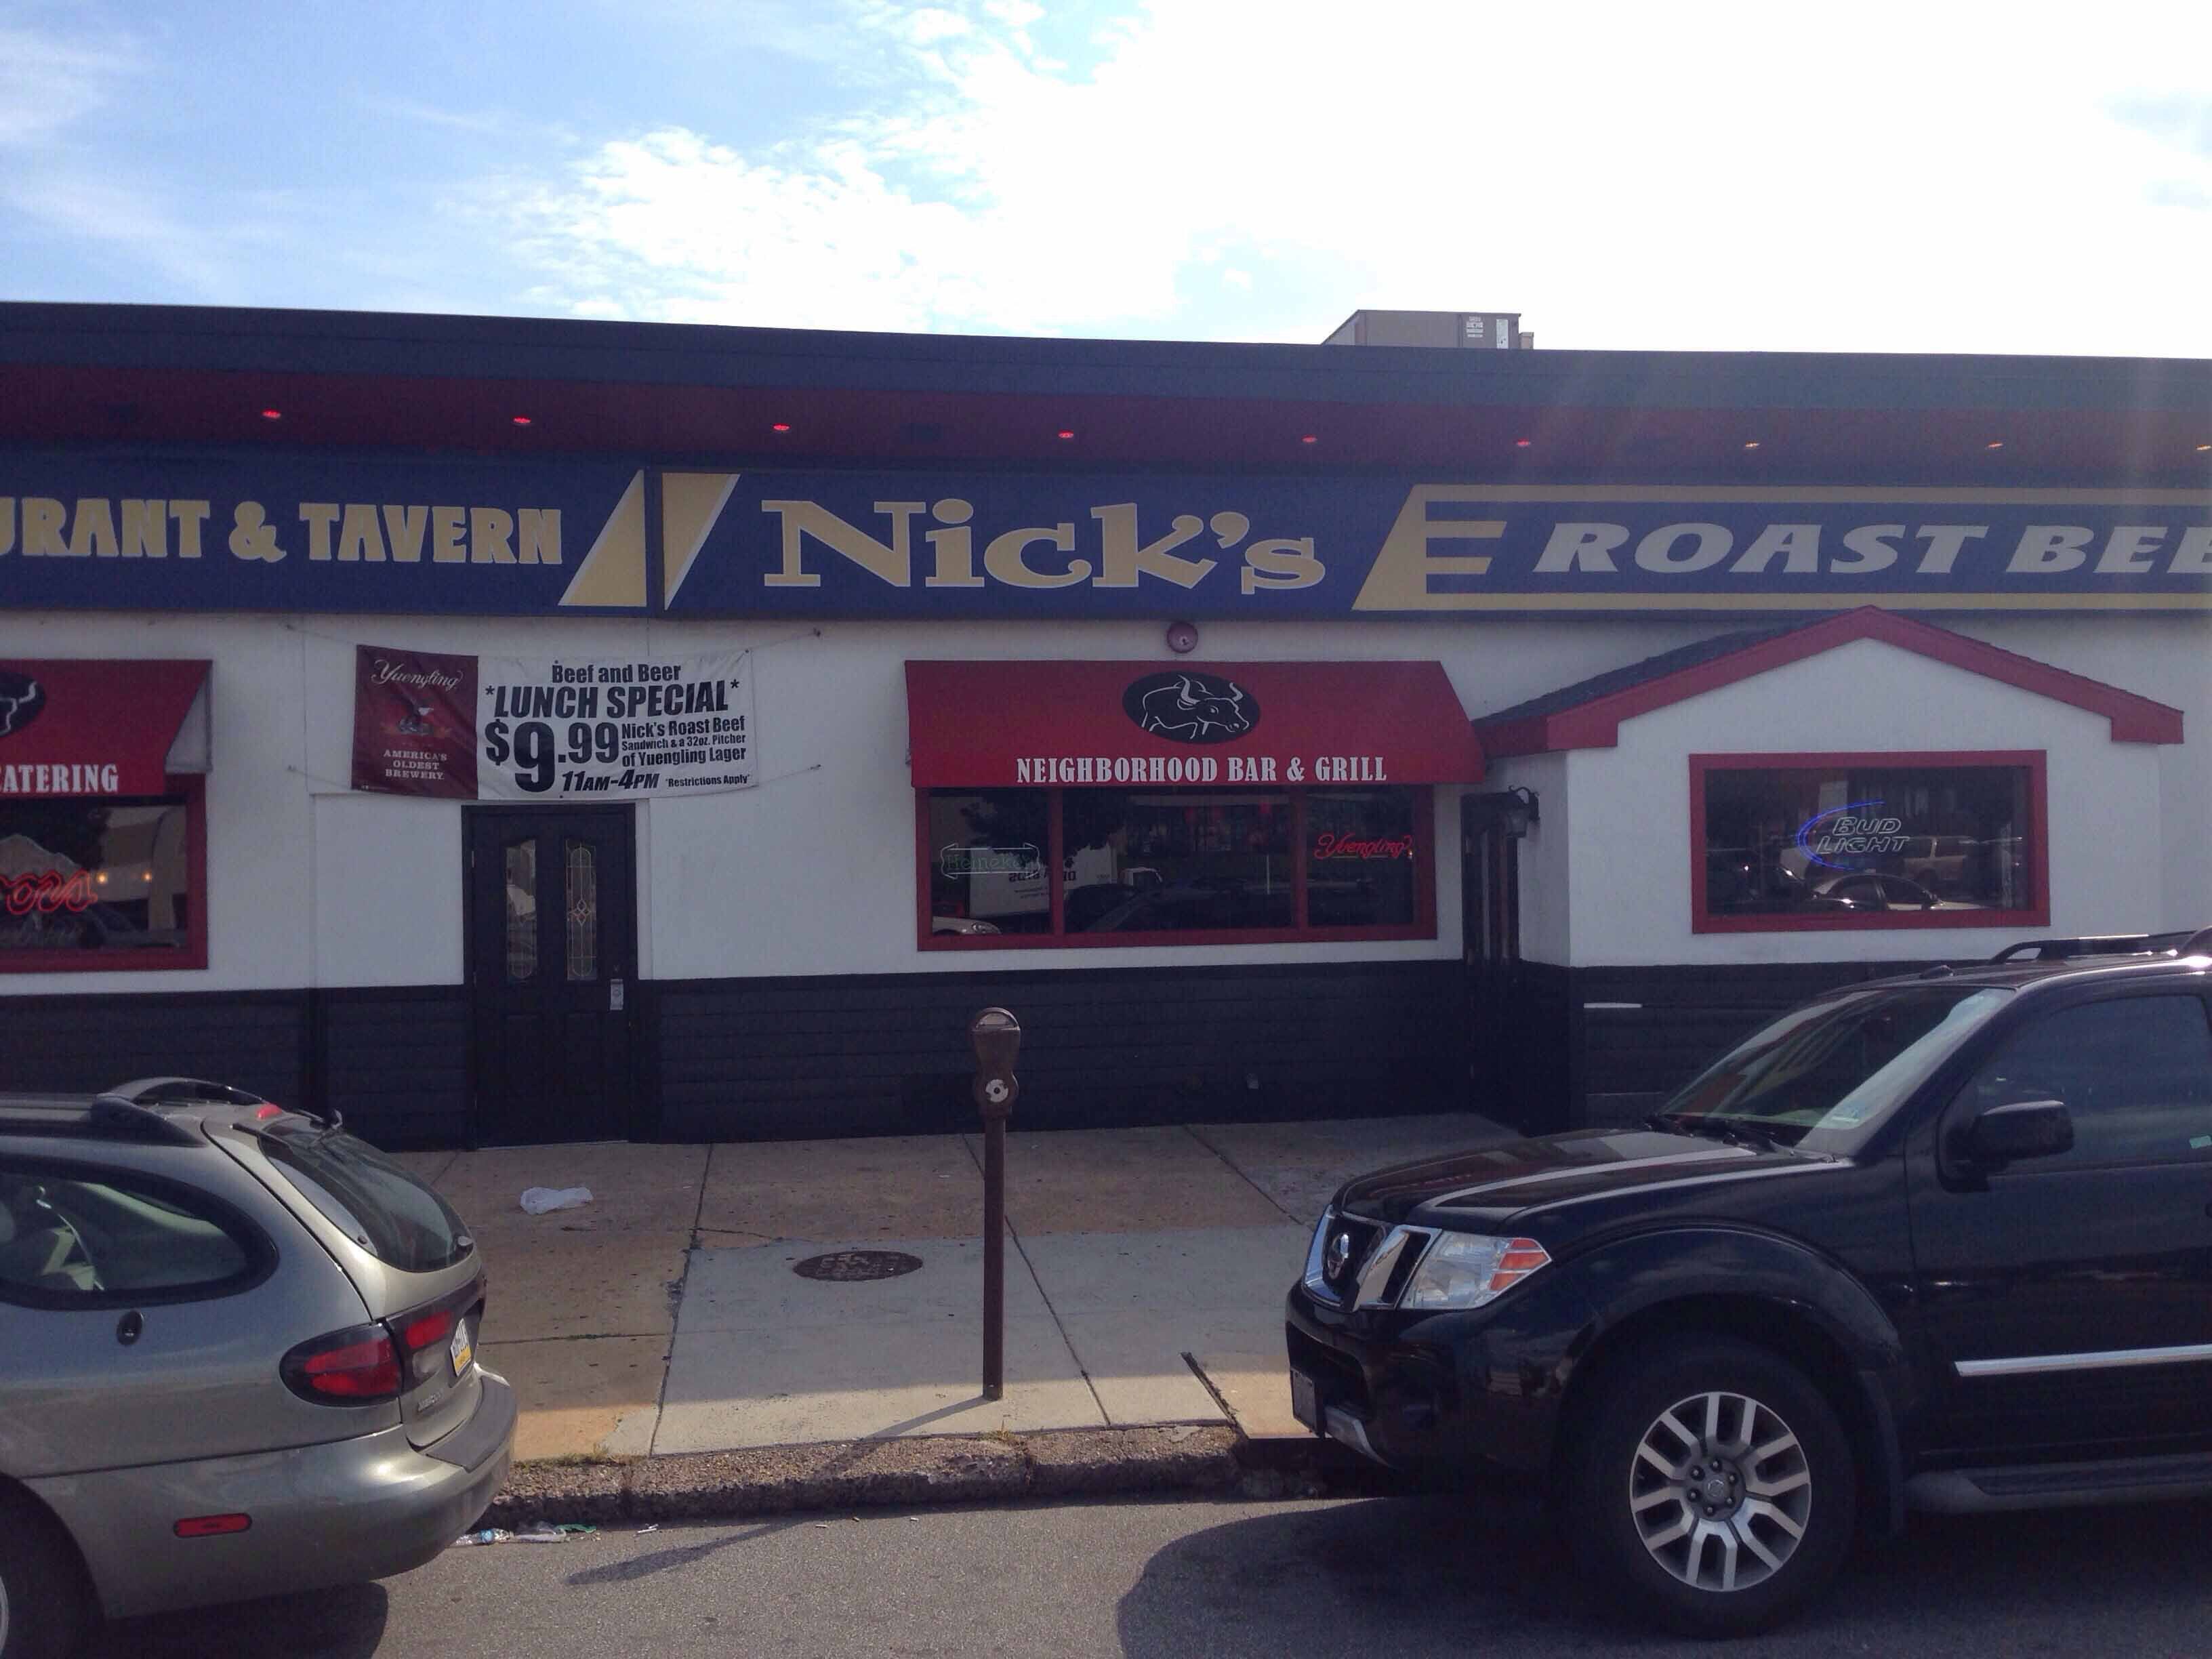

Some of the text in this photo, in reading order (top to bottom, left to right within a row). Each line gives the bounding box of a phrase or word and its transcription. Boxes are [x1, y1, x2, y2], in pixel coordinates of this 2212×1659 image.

[228, 501, 287, 562] &
[299, 501, 562, 565] TAVERN
[760, 498, 1326, 595] Nick's
[1532, 522, 1989, 575] ROAST
[371, 659, 464, 691] Yuengling
[552, 664, 681, 684] Beef and Beer
[621, 716, 745, 739] Nick's Roast Beef
[383, 749, 447, 761] AMERICA'S
[485, 718, 619, 793] $9.99
[621, 733, 745, 752] Sandwich & a 32oz. Pitcher
[392, 760, 440, 771] OLDEST
[622, 747, 746, 767] of Yuengling Lager
[1017, 756, 1387, 783] NEIGHBORHOOD BAR & GRILL
[0, 764, 119, 793] ATERING
[562, 769, 660, 792] 11AM-4PM
[1313, 831, 1414, 861] Yuengling
